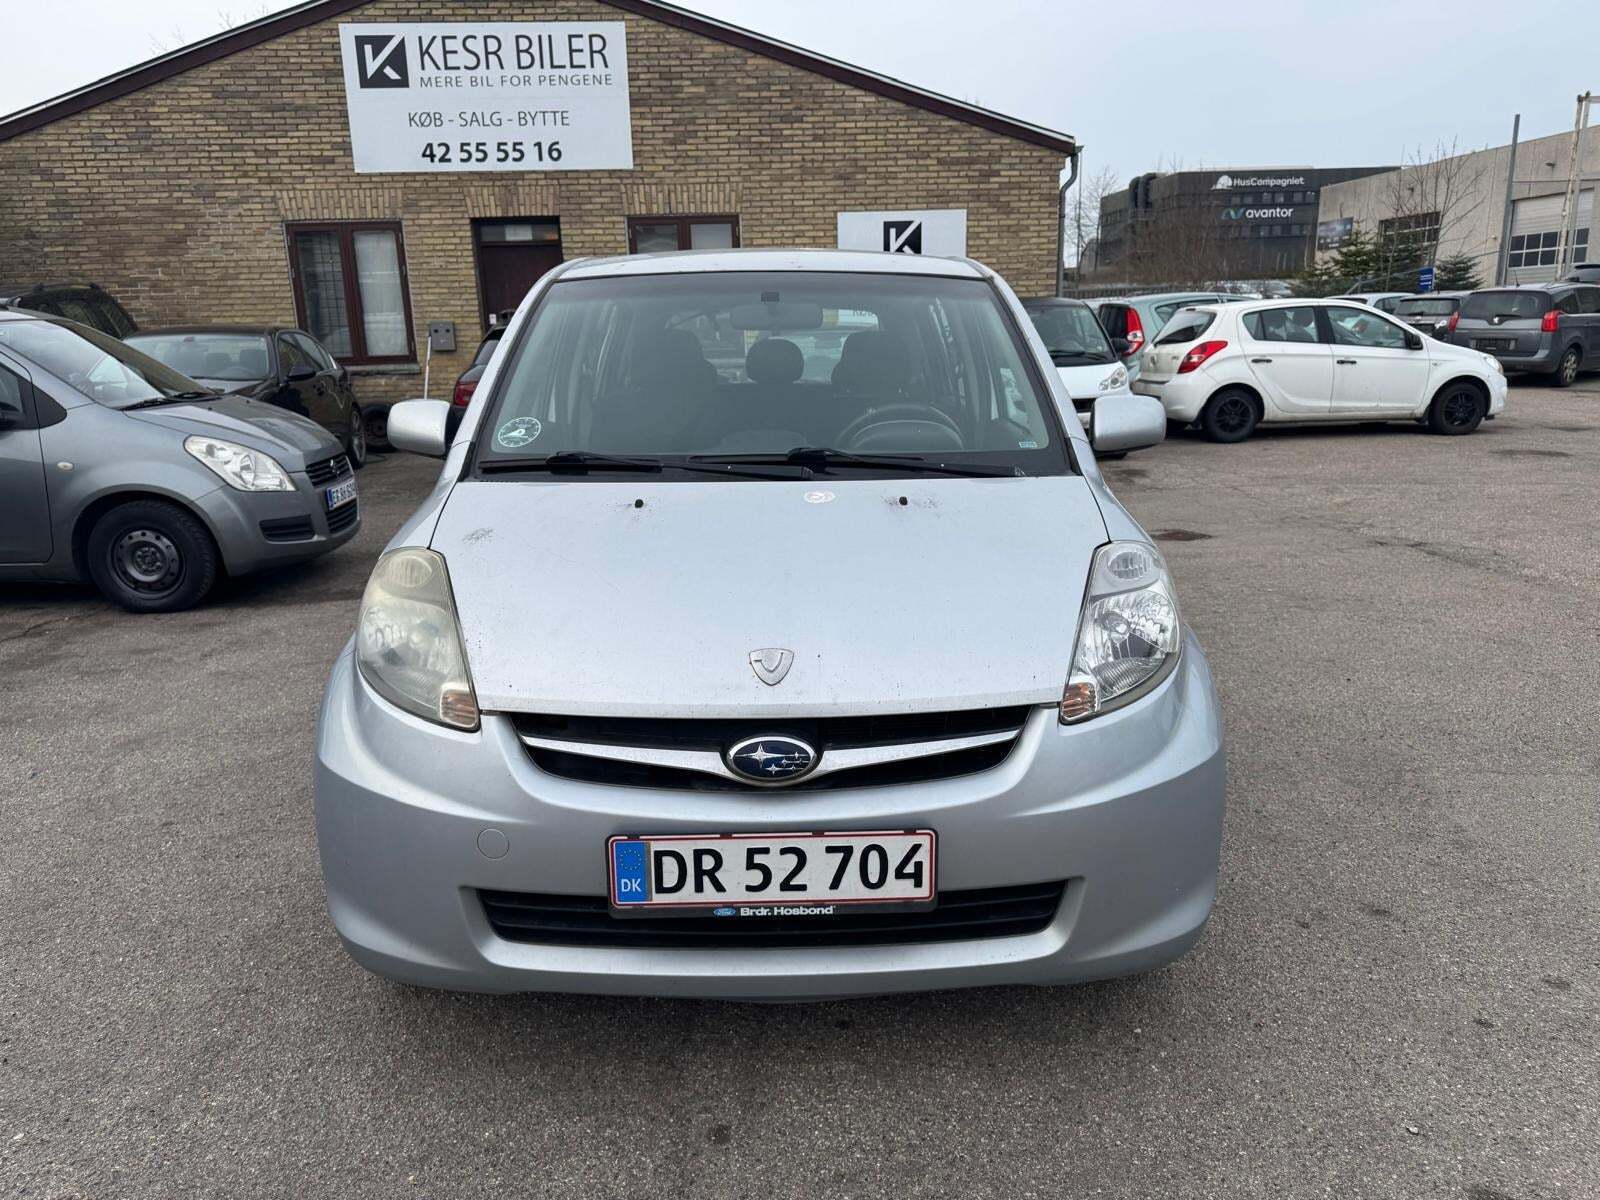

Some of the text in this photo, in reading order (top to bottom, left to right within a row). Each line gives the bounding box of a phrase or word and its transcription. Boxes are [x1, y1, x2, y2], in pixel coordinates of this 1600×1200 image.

[418, 34, 609, 71] KESR BILER
[420, 74, 613, 88] MERE BIL FOR PENGENE
[408, 111, 444, 128] KØB
[459, 111, 502, 127] SALG
[518, 110, 570, 127] BYTTE
[421, 141, 562, 163] 42 55 55 16
[1233, 176, 1305, 188] HusCompagniet
[1245, 207, 1294, 219] avantor
[653, 843, 924, 894] DR 52 704
[621, 878, 642, 893] DK
[740, 906, 833, 916] Brdr. Hosbond
